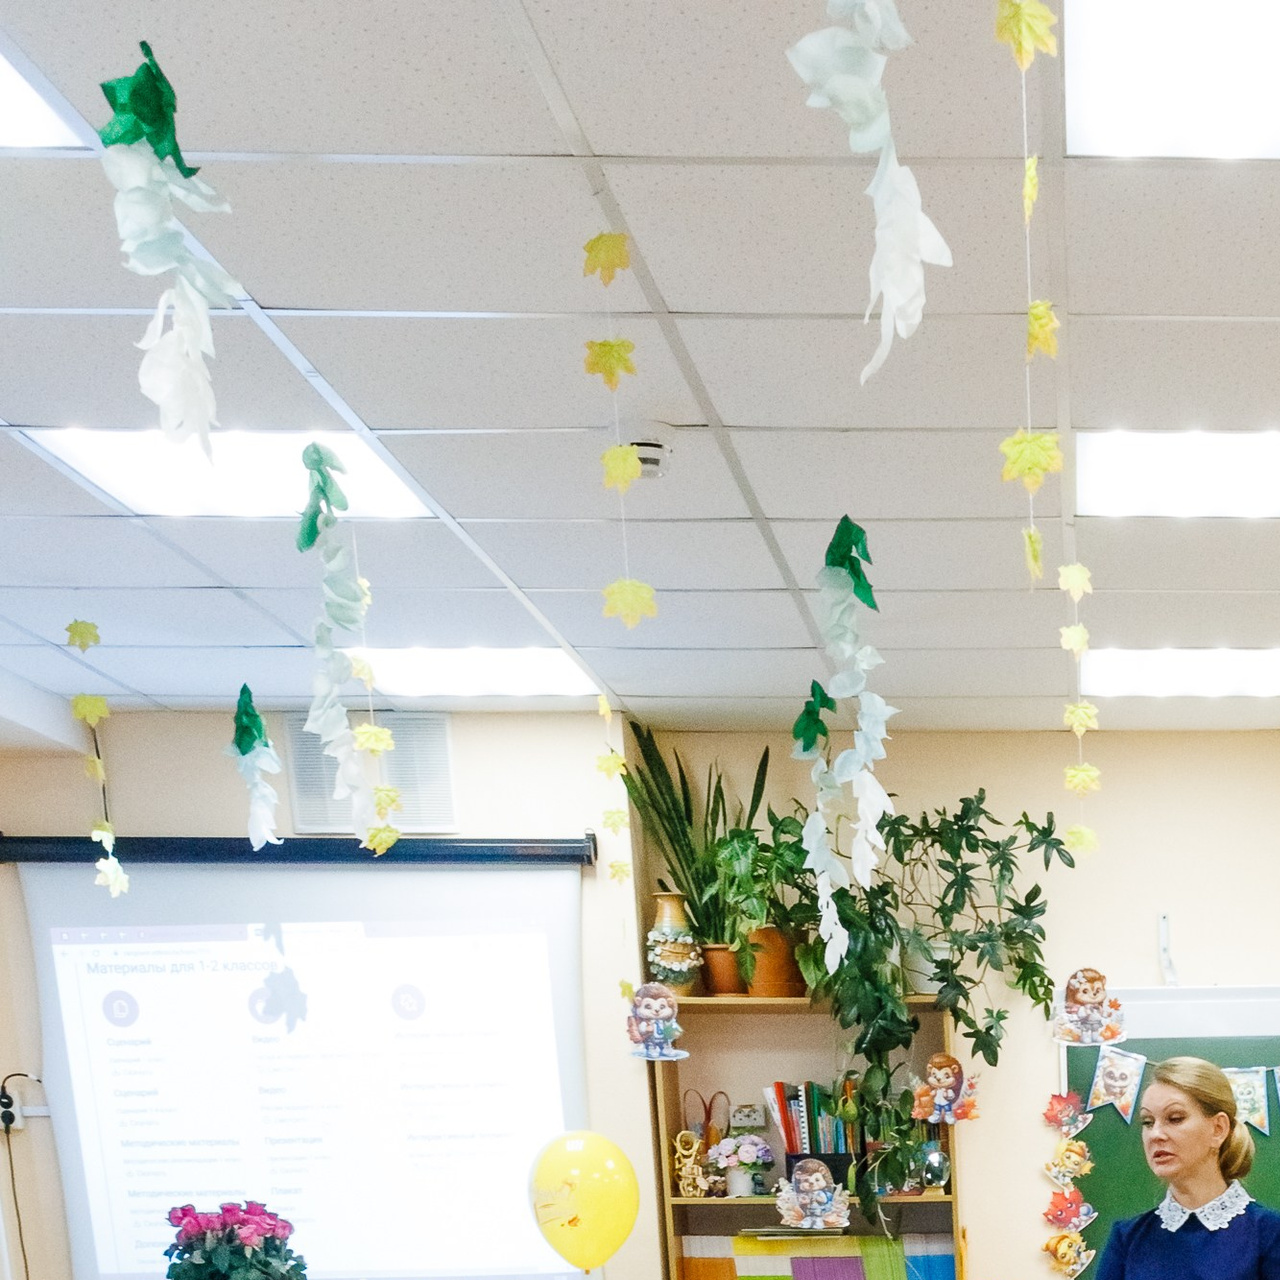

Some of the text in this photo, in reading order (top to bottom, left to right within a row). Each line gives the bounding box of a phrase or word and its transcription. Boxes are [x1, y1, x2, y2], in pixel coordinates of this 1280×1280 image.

[86, 959, 277, 977] Материалы для 1-2 классов
